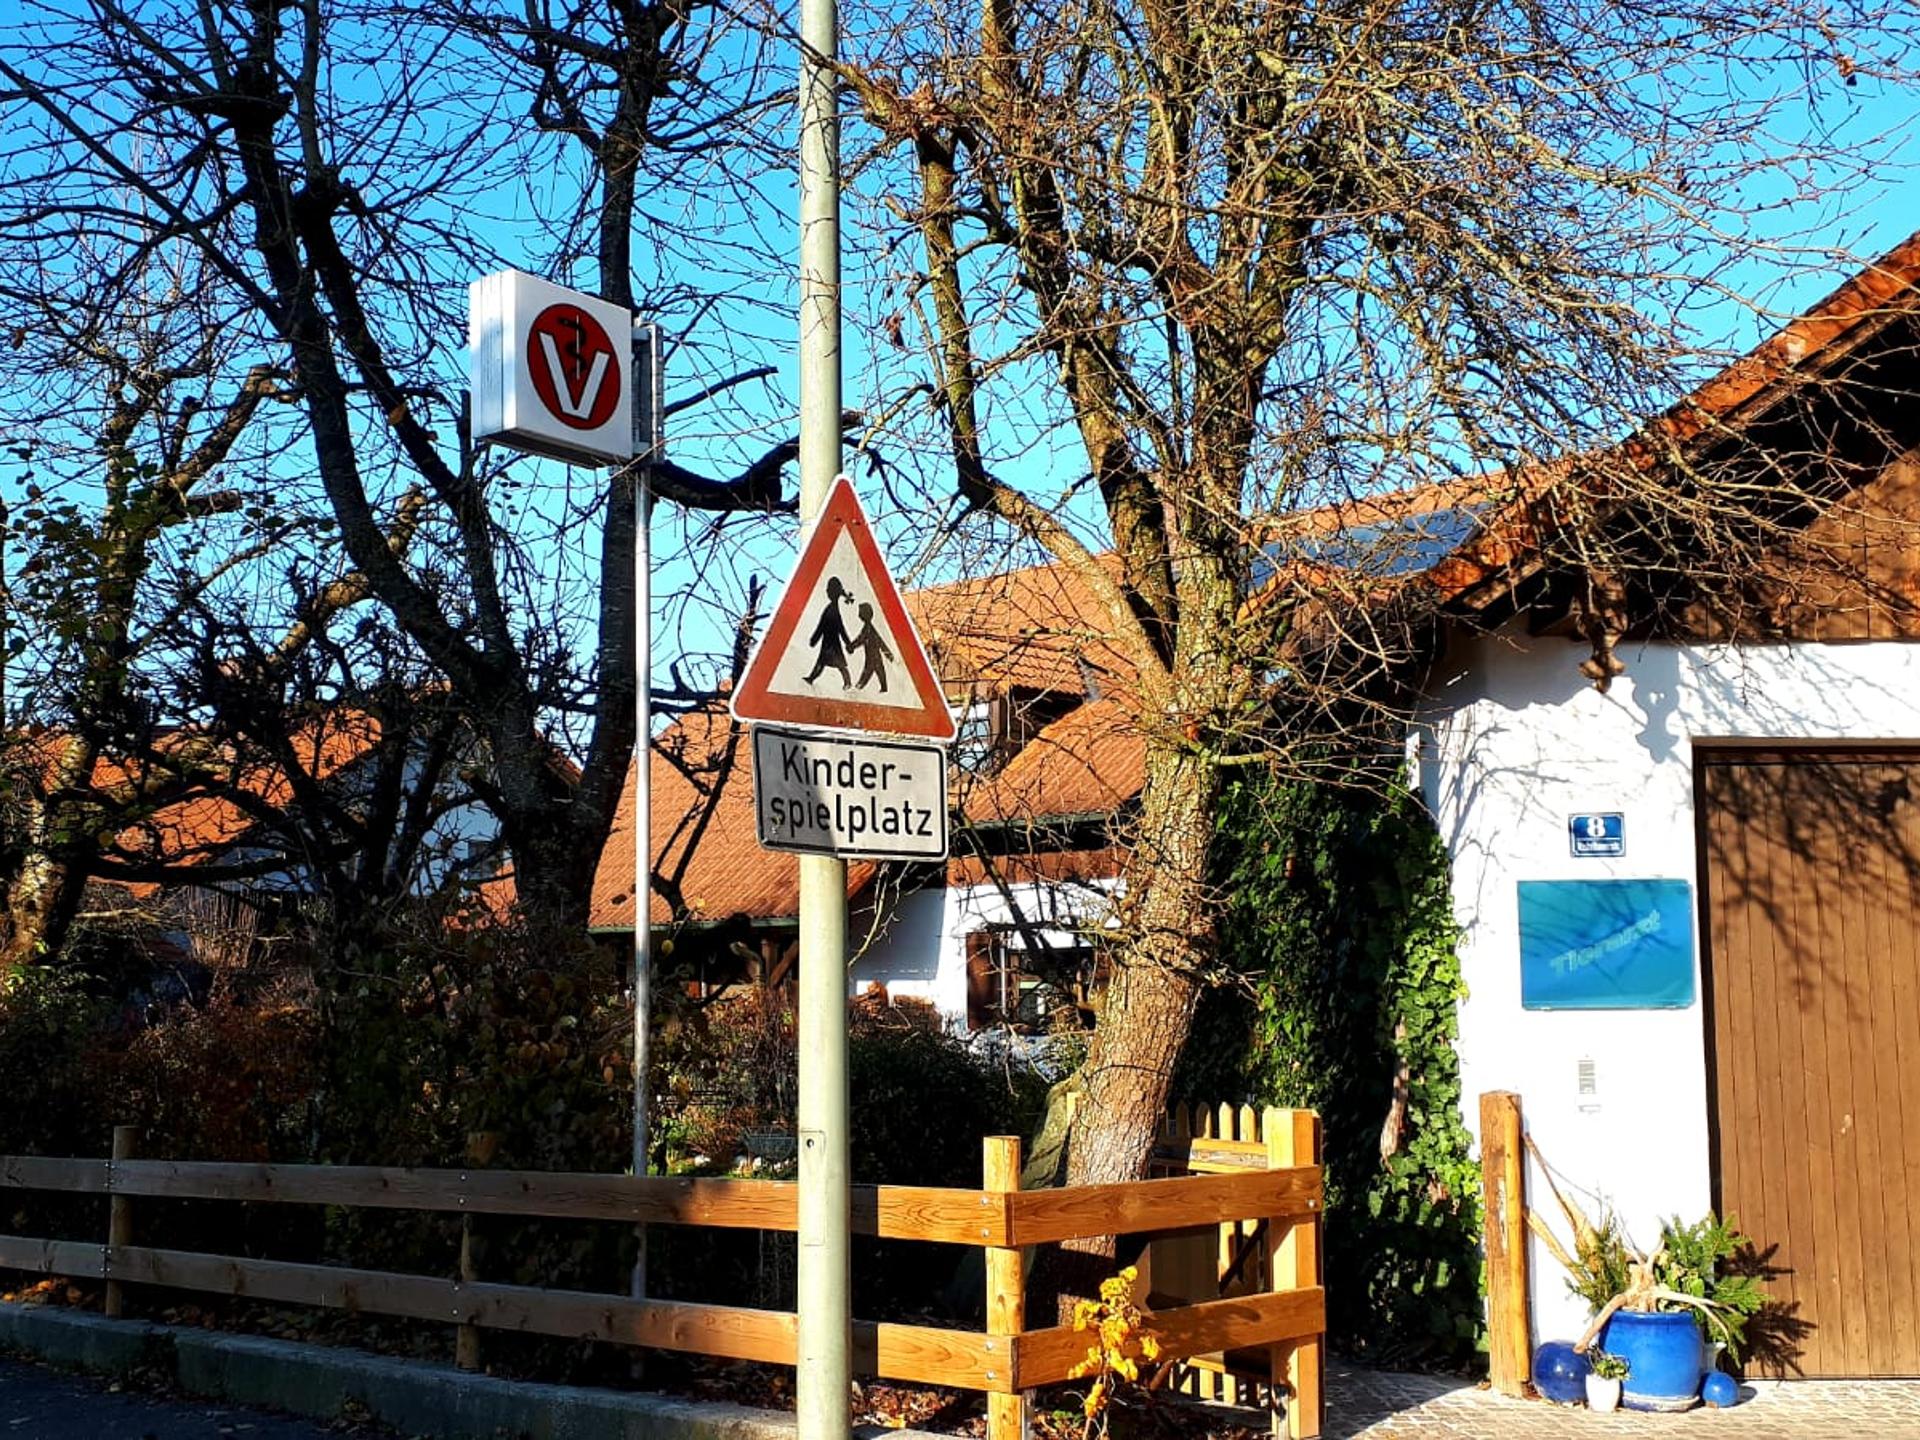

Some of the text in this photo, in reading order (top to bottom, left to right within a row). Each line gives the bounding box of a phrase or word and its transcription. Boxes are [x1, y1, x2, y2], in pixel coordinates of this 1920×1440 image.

[539, 331, 610, 421] V
[781, 742, 913, 790] Kinder-
[770, 791, 933, 843] spielplatz
[1587, 816, 1605, 837] 8
